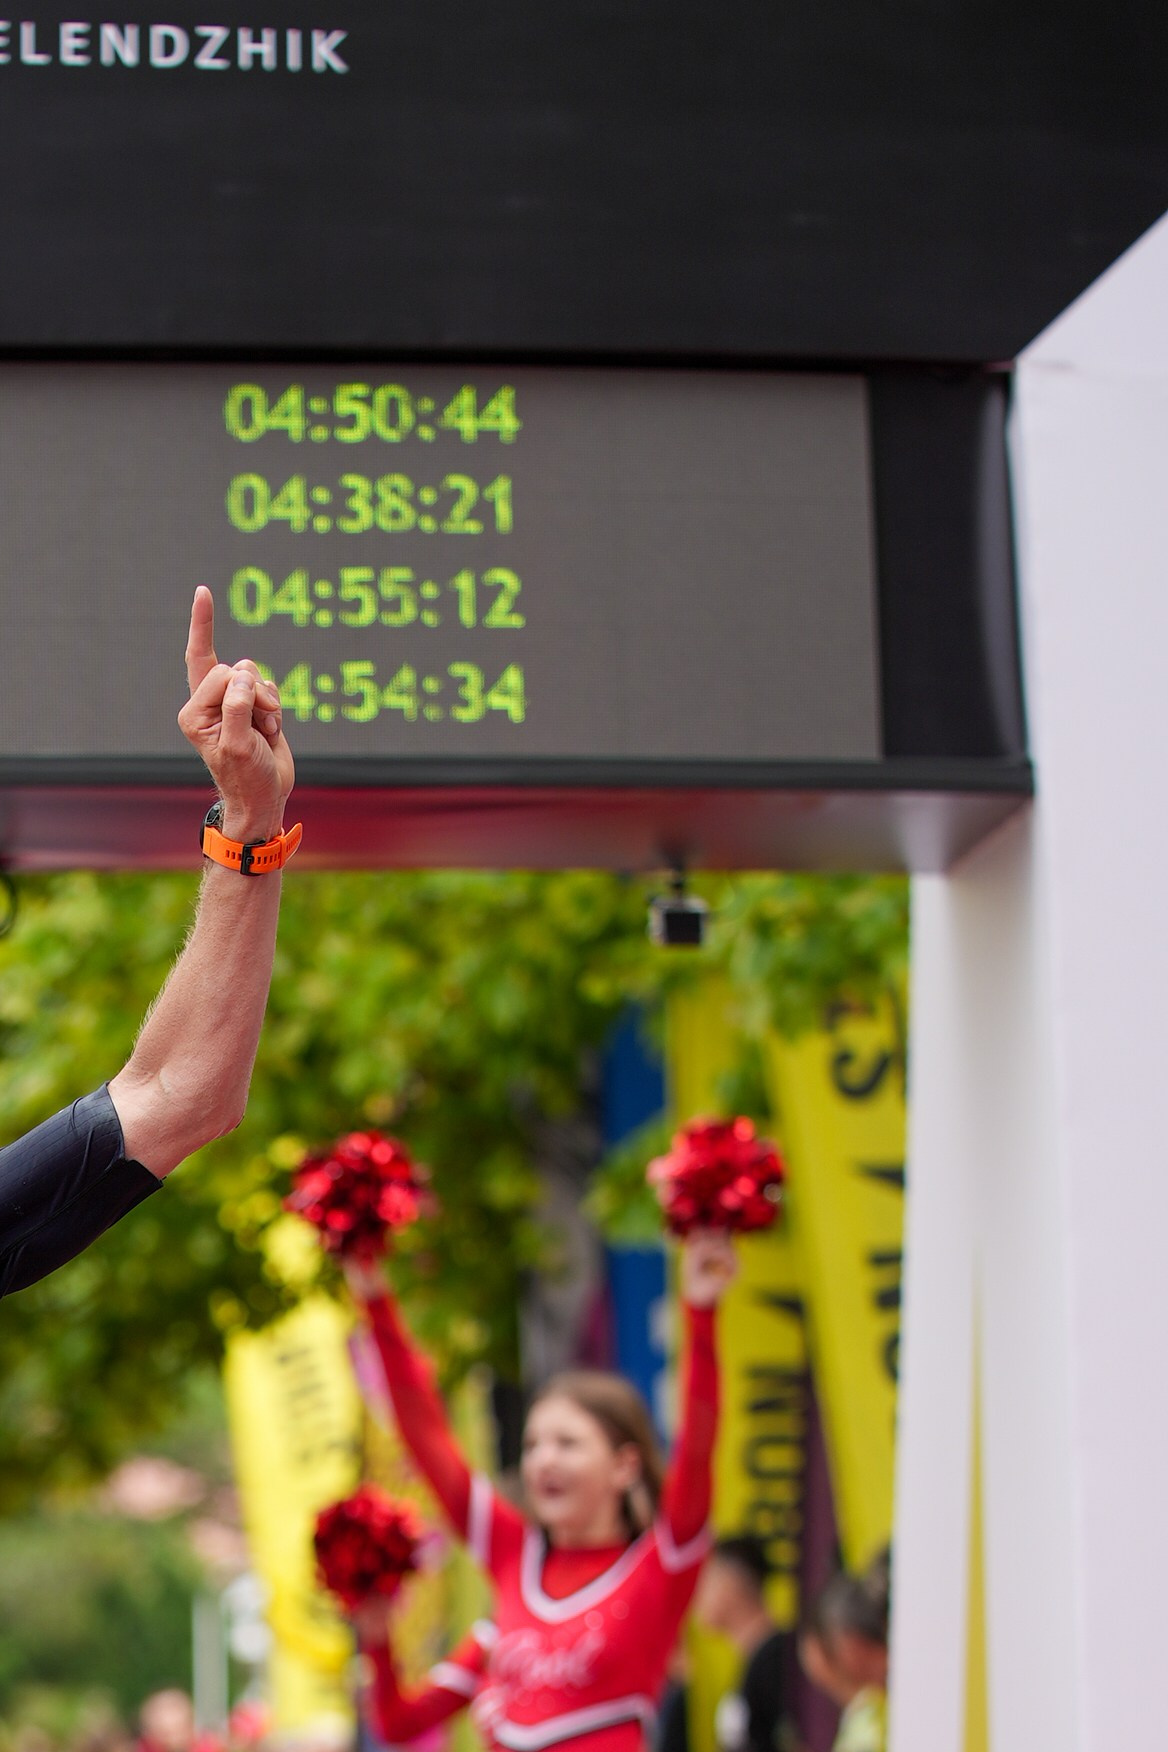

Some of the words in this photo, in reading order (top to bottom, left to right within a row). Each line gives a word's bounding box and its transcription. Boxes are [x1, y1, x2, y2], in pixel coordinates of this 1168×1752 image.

[224, 382, 523, 444] 04:50:44
[225, 472, 514, 535] 04:38:21
[228, 565, 526, 629] 04:55:12
[256, 659, 528, 724] 4:54:34
